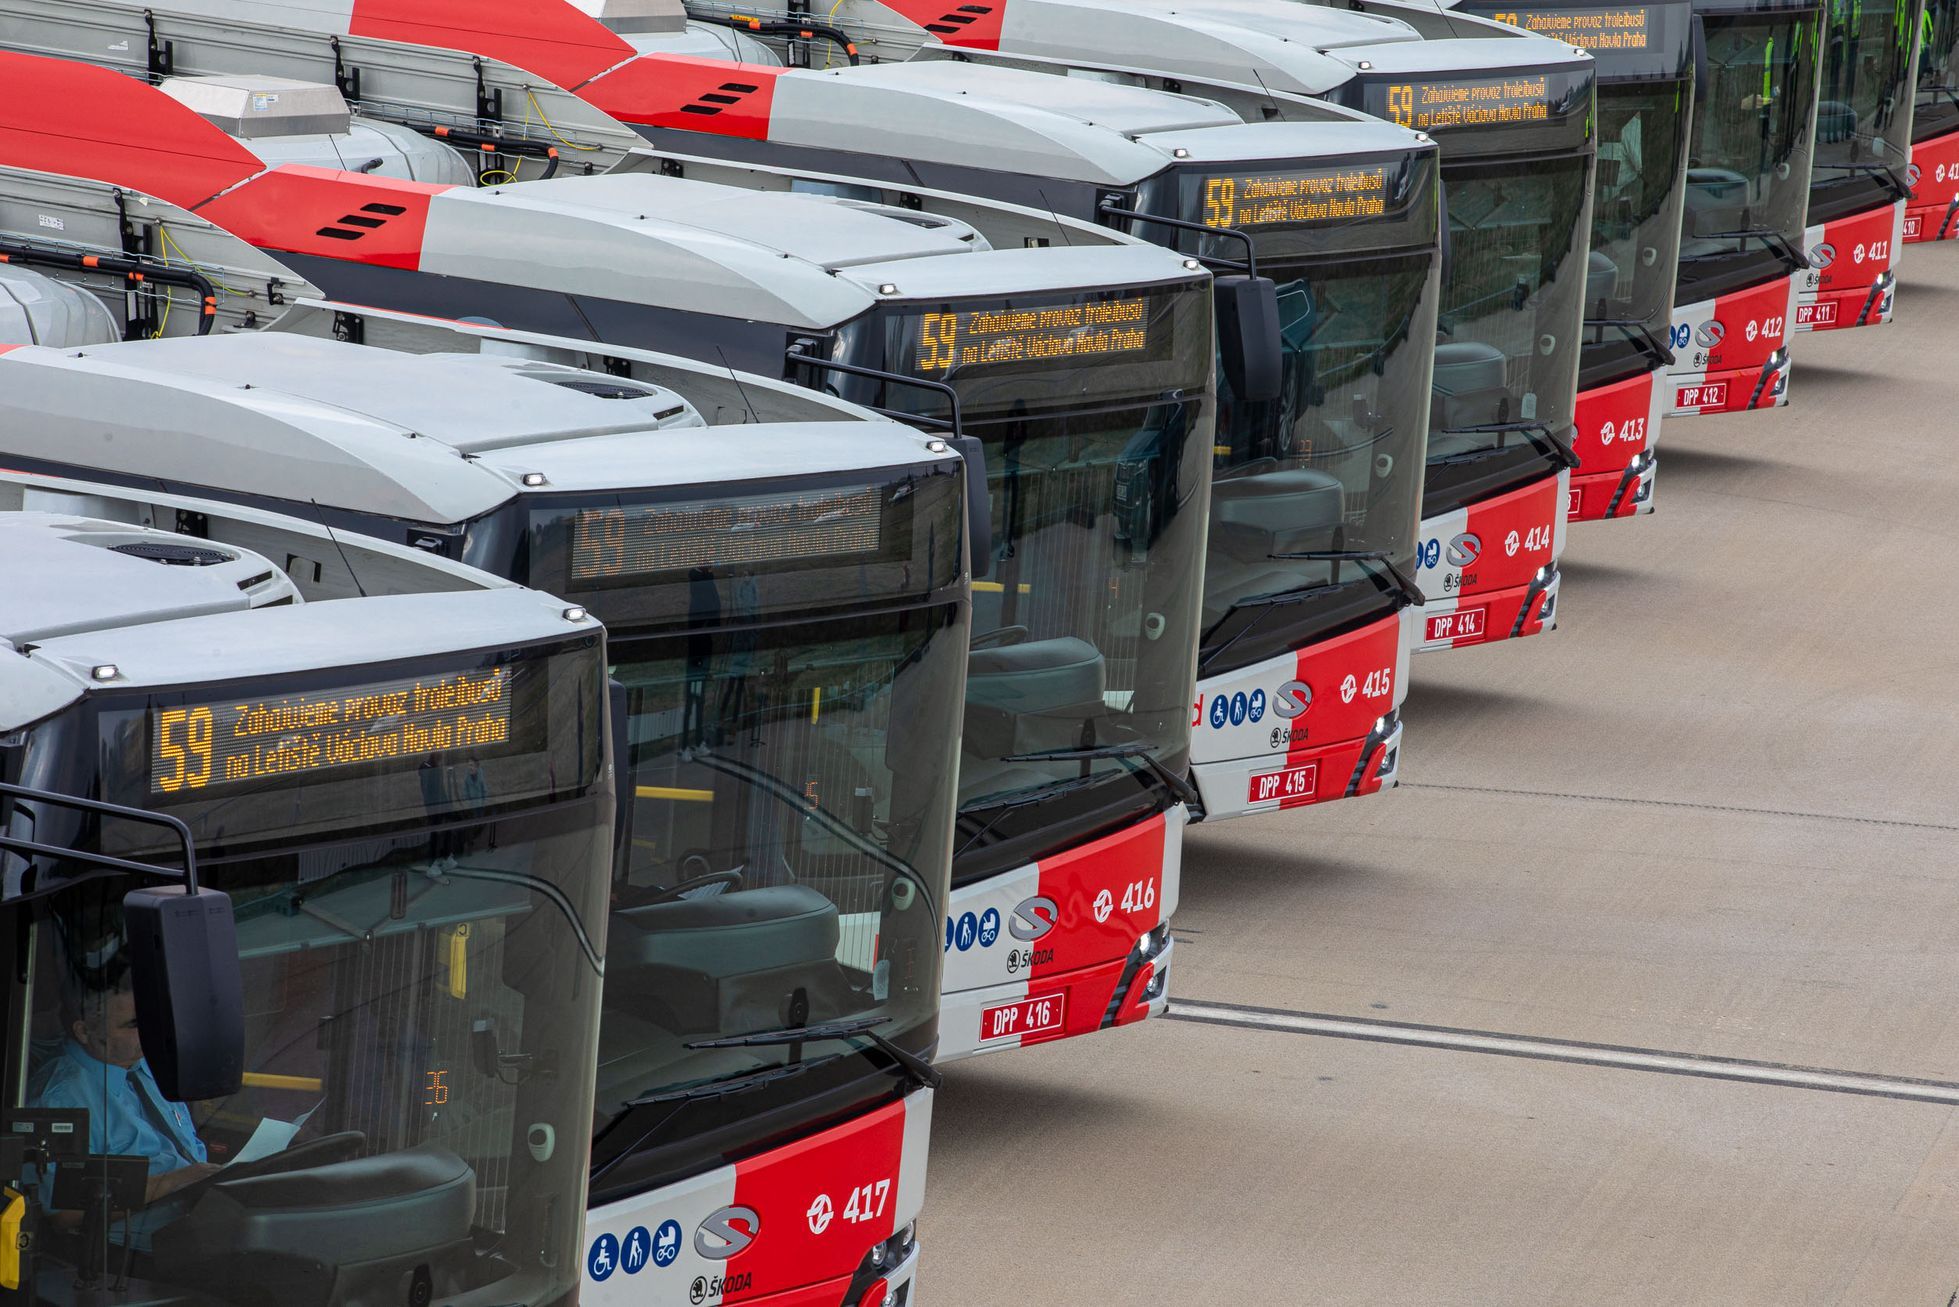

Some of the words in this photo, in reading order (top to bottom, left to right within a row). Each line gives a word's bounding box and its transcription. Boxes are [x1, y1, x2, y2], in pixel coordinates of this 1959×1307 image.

[1388, 84, 1413, 129] 59
[1948, 162, 1959, 180] 41
[1205, 177, 1236, 228] 59
[1868, 240, 1888, 260] 411
[969, 310, 1037, 334] Zahajujeme
[1039, 308, 1082, 328] provoz
[1085, 298, 1143, 325] trolejbusů
[1761, 316, 1782, 338] 412
[1798, 307, 1813, 322] DPP
[1816, 305, 1830, 320] 411
[920, 313, 957, 370] 59
[962, 346, 977, 364] na
[1026, 333, 1073, 358] Václava
[1075, 330, 1108, 353] Havla
[1110, 328, 1145, 351] Praha
[1683, 388, 1699, 405] DPP
[1703, 387, 1718, 404] 412
[1619, 418, 1644, 442] 413
[579, 509, 625, 577] 59
[1524, 524, 1550, 551] 414
[1434, 617, 1452, 638] DPP
[1458, 614, 1475, 634] 414
[1361, 667, 1390, 699] 415
[233, 697, 339, 737] Zahajujeme
[345, 691, 408, 722] provoz
[414, 667, 502, 713] trolejbusů
[159, 706, 213, 793] 59
[225, 753, 249, 780] na
[254, 732, 321, 776] Letiště
[326, 729, 398, 764] Václava
[403, 720, 452, 754] Havla
[456, 713, 506, 747] Praha
[1281, 728, 1309, 744] ŠKODA
[1259, 776, 1280, 799] DPP
[1285, 771, 1306, 794] 415
[1120, 877, 1155, 914] 416
[1020, 948, 1054, 968] ŠKODA
[993, 1007, 1018, 1035] DPP
[1026, 1000, 1050, 1028] 416
[842, 1178, 891, 1224] 417
[708, 1271, 752, 1298] ŠKODA
